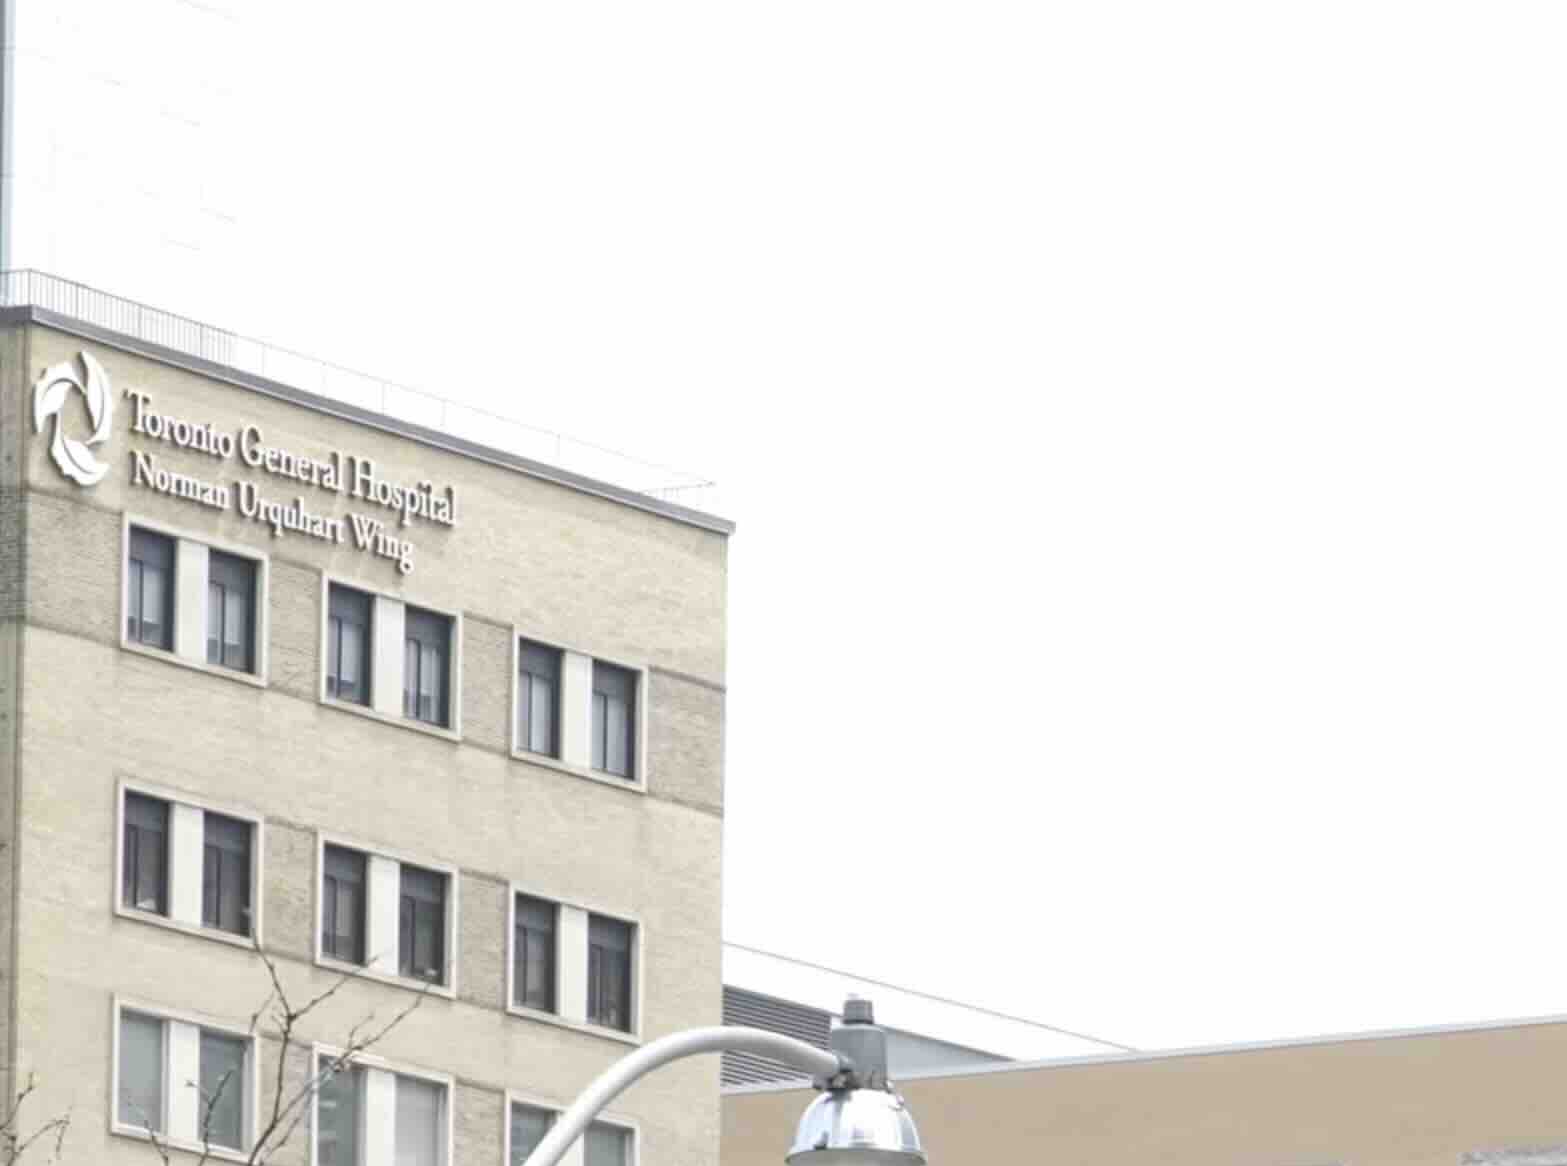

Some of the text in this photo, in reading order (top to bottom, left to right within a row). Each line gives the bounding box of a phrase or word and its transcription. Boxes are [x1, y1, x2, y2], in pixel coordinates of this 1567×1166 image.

[126, 390, 457, 528] Toronto General Hospital
[131, 450, 415, 572] Norman Urquhart Wing
